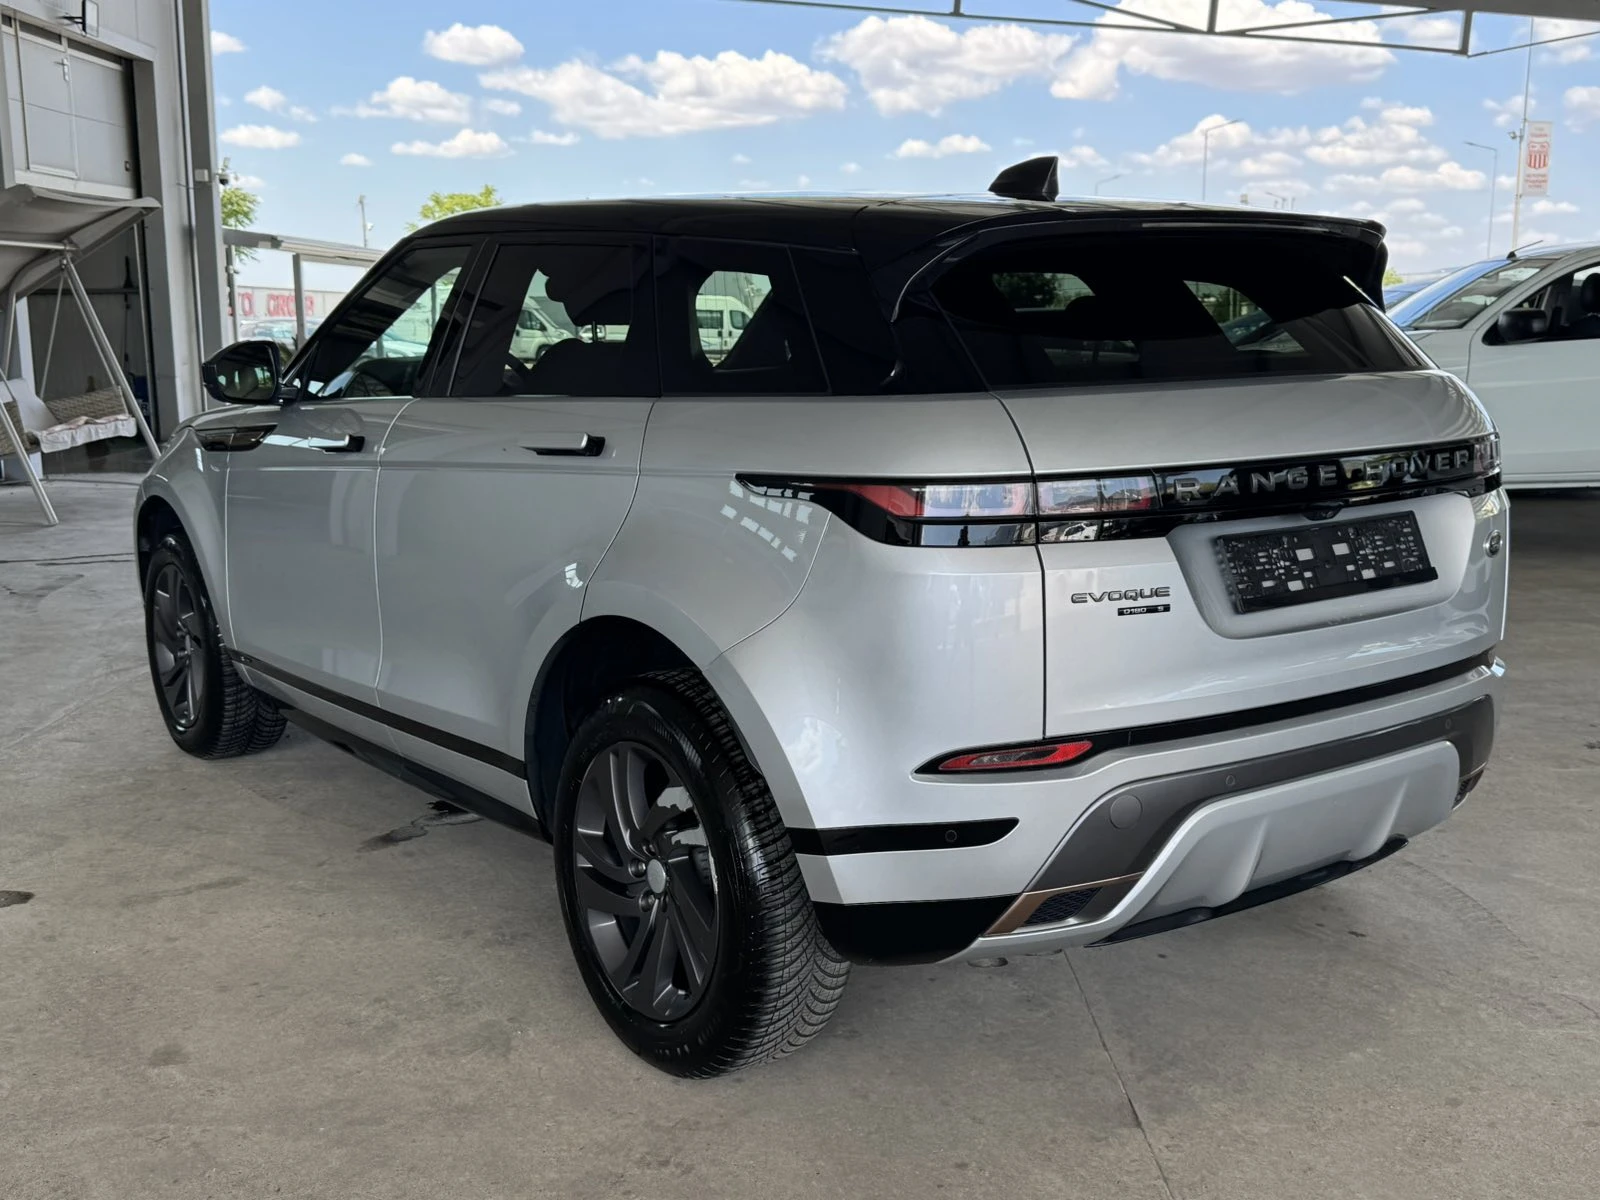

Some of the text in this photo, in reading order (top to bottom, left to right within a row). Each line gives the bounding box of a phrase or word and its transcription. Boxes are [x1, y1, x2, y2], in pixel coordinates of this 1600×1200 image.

[267, 293, 314, 317] GROP
[1174, 450, 1469, 501] RANGE ROVER
[1070, 586, 1170, 604] EVOQUE
